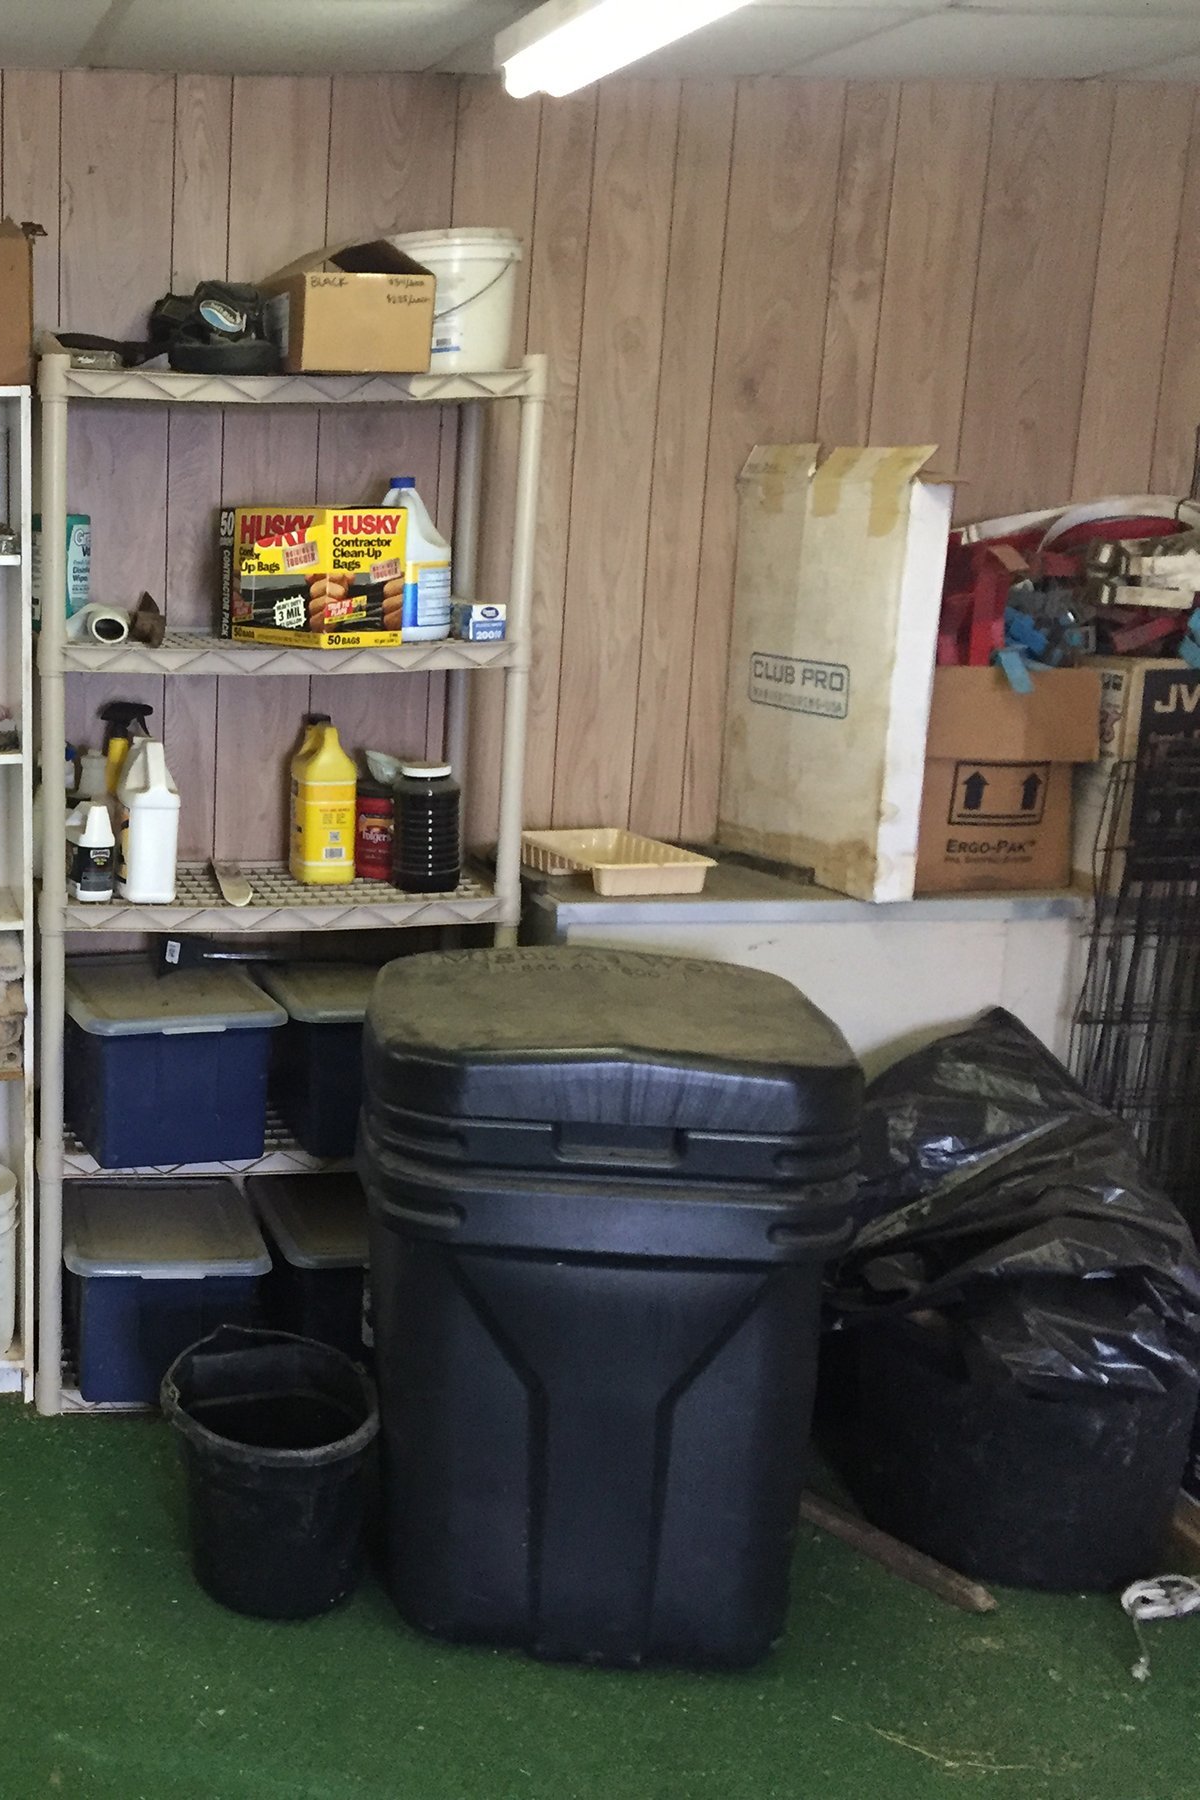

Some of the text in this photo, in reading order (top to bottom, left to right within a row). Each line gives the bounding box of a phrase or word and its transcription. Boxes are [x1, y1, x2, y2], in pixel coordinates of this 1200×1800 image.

[310, 277, 349, 288] BLACK
[220, 511, 235, 535] 50
[333, 514, 402, 535] HUSKY
[240, 514, 313, 548] HUSKY
[333, 536, 393, 548] Contractor
[333, 547, 383, 560] Clean-Up
[257, 561, 282, 573] Bags
[333, 559, 362, 572] Bags
[222, 549, 232, 609] CONTRACTOR
[278, 607, 302, 622] 3 MIL
[221, 611, 232, 637] PACK
[233, 626, 243, 637] 50
[327, 635, 341, 645] 50
[342, 636, 361, 645] BAGS
[753, 659, 845, 691] CLUB PRO
[1153, 683, 1200, 713] JV
